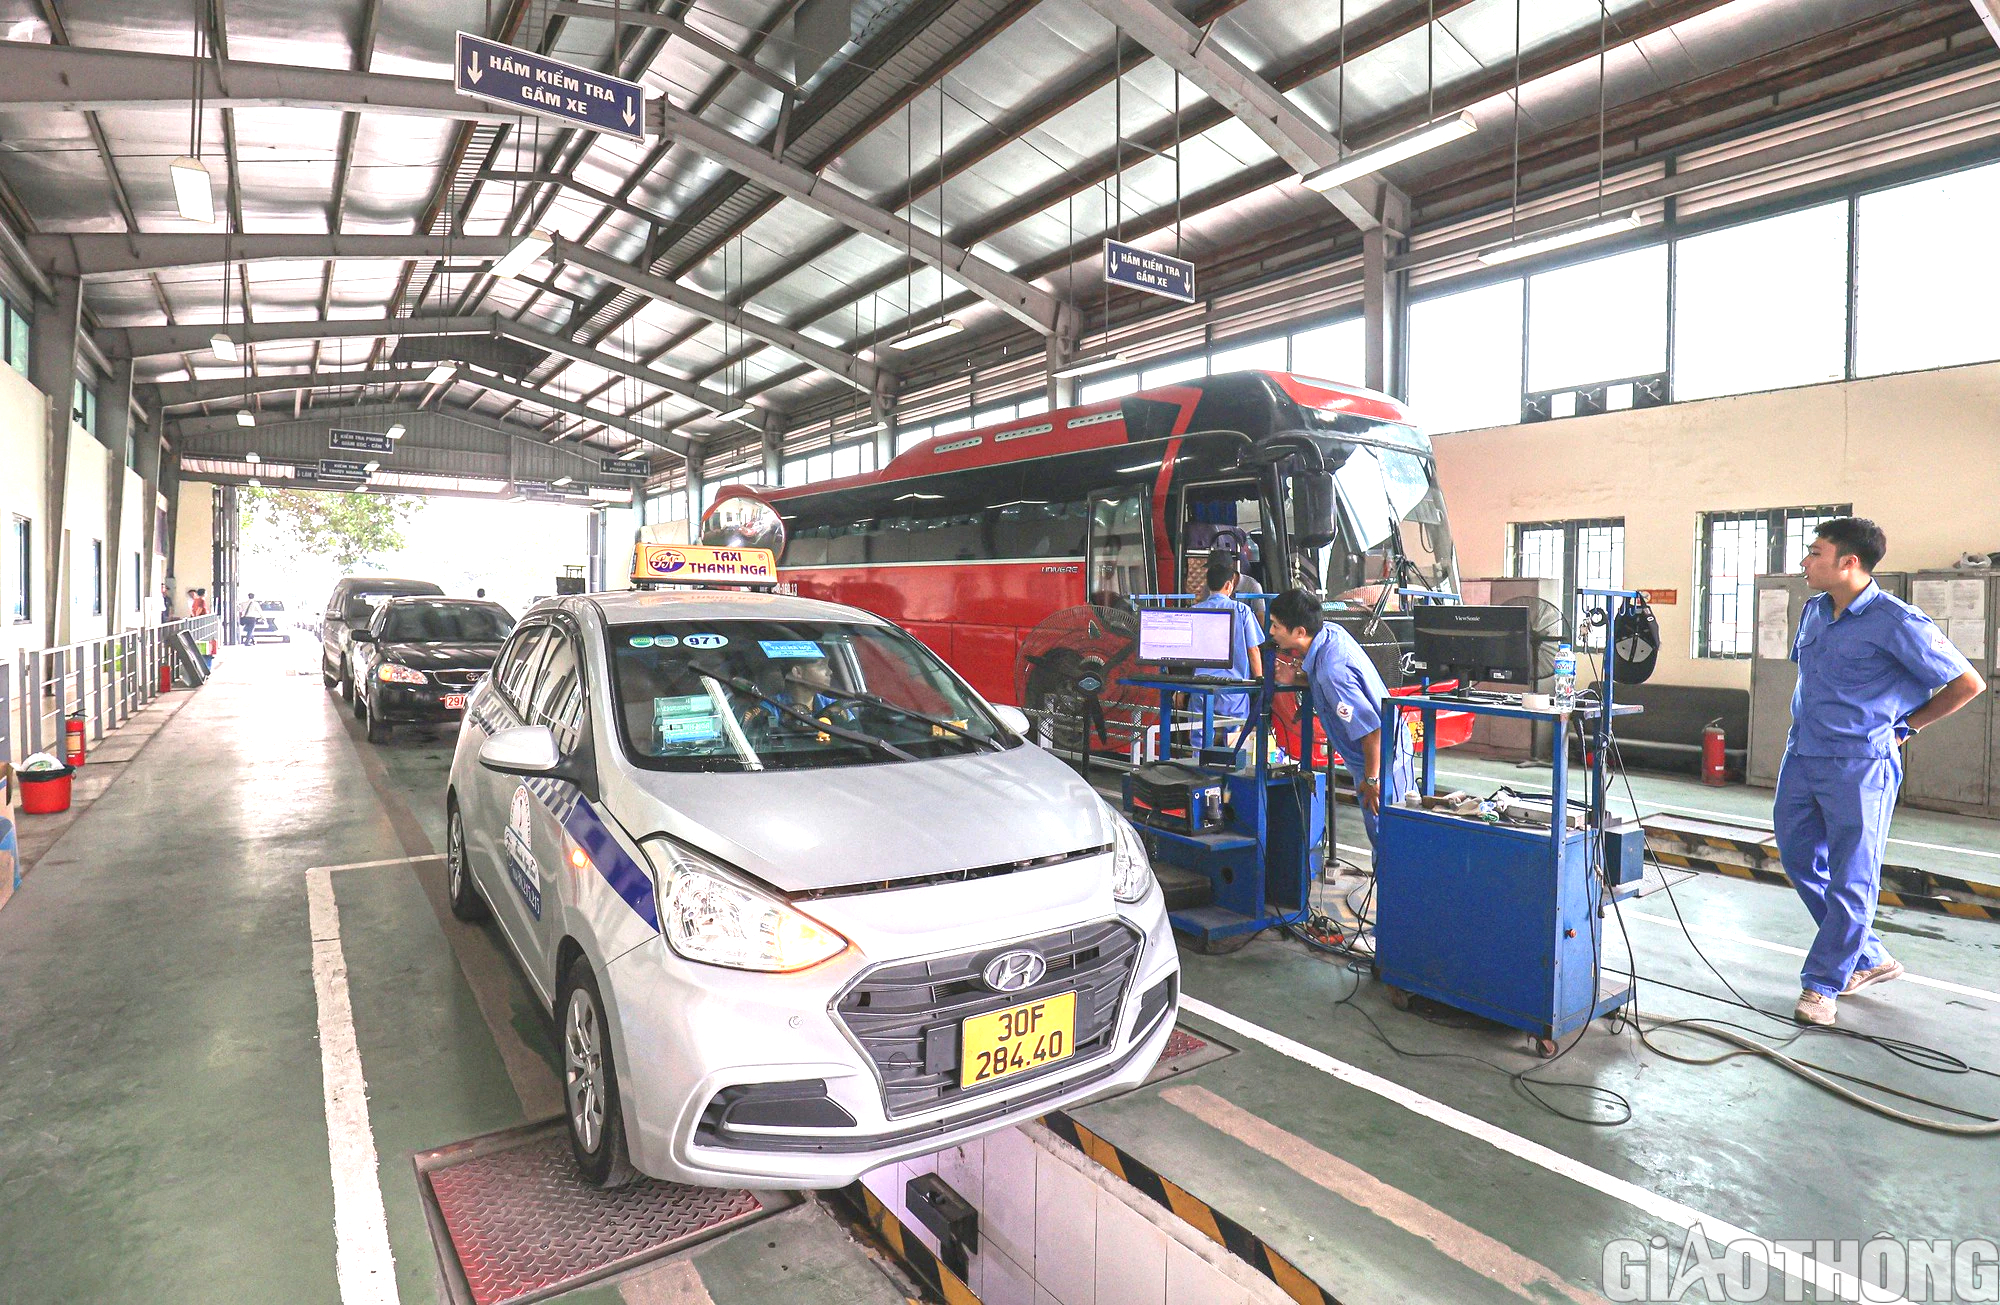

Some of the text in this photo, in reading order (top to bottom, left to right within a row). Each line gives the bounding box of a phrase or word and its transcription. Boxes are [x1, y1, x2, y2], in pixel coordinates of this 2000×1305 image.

[489, 55, 615, 103] HẦM KIỂM TRA
[521, 85, 588, 115] GẦM XE
[1142, 258, 1163, 273] KIỂM
[1164, 265, 1180, 277] TRA
[1157, 278, 1168, 288] XE
[712, 551, 742, 562] TAXI
[688, 562, 767, 576] THANH NGA
[688, 636, 721, 646] 971
[998, 1004, 1045, 1042] 30F
[975, 1030, 1063, 1082] 284.40
